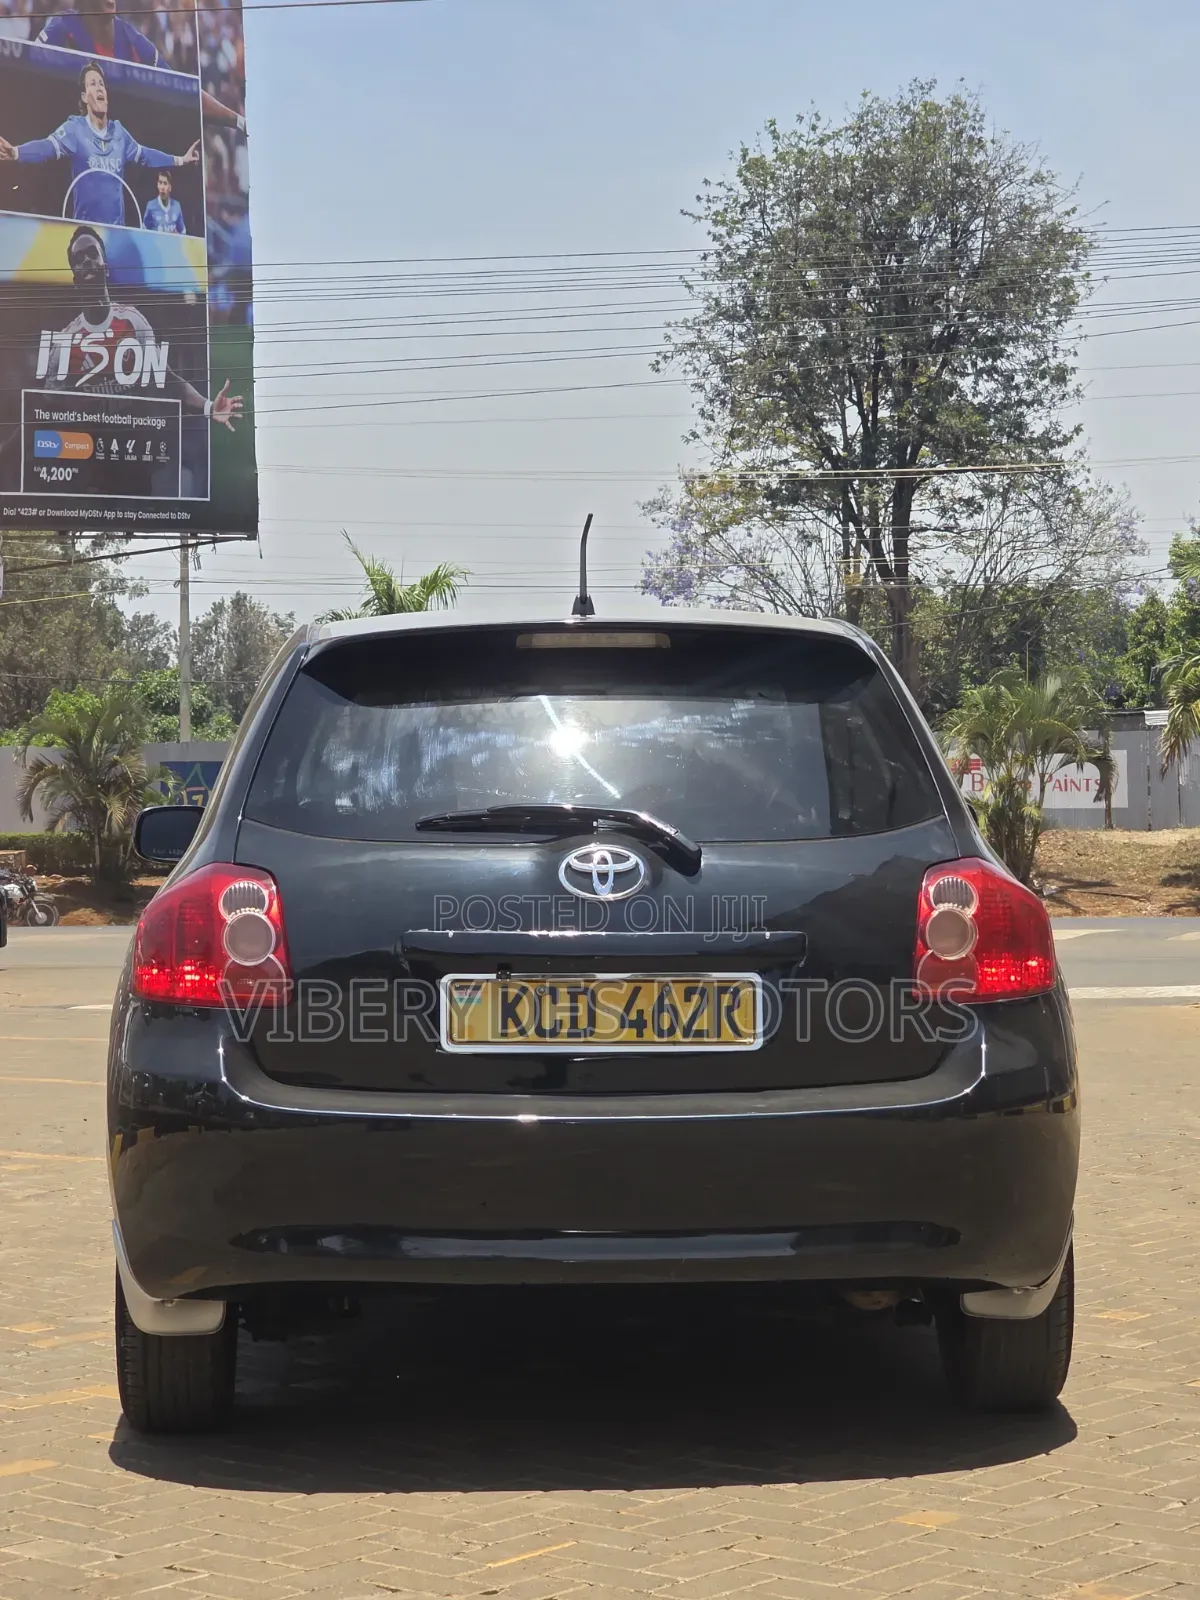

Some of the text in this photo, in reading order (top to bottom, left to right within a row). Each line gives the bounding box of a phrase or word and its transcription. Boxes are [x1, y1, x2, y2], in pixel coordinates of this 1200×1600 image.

[35, 330, 169, 388] IT'S ON
[34, 409, 166, 429] The world's best football package
[37, 440, 59, 449] DStv
[64, 441, 89, 451] Compact
[39, 466, 73, 482] 4,200
[3, 507, 16, 516] Dial
[47, 508, 79, 517] Download
[79, 509, 103, 519] MyDStv
[103, 510, 116, 519] App
[124, 511, 137, 520] stay
[137, 511, 170, 519] Connected
[170, 512, 177, 520] to
[177, 512, 191, 520] DStv
[500, 985, 596, 1038] KCD
[620, 986, 742, 1038] 462R
